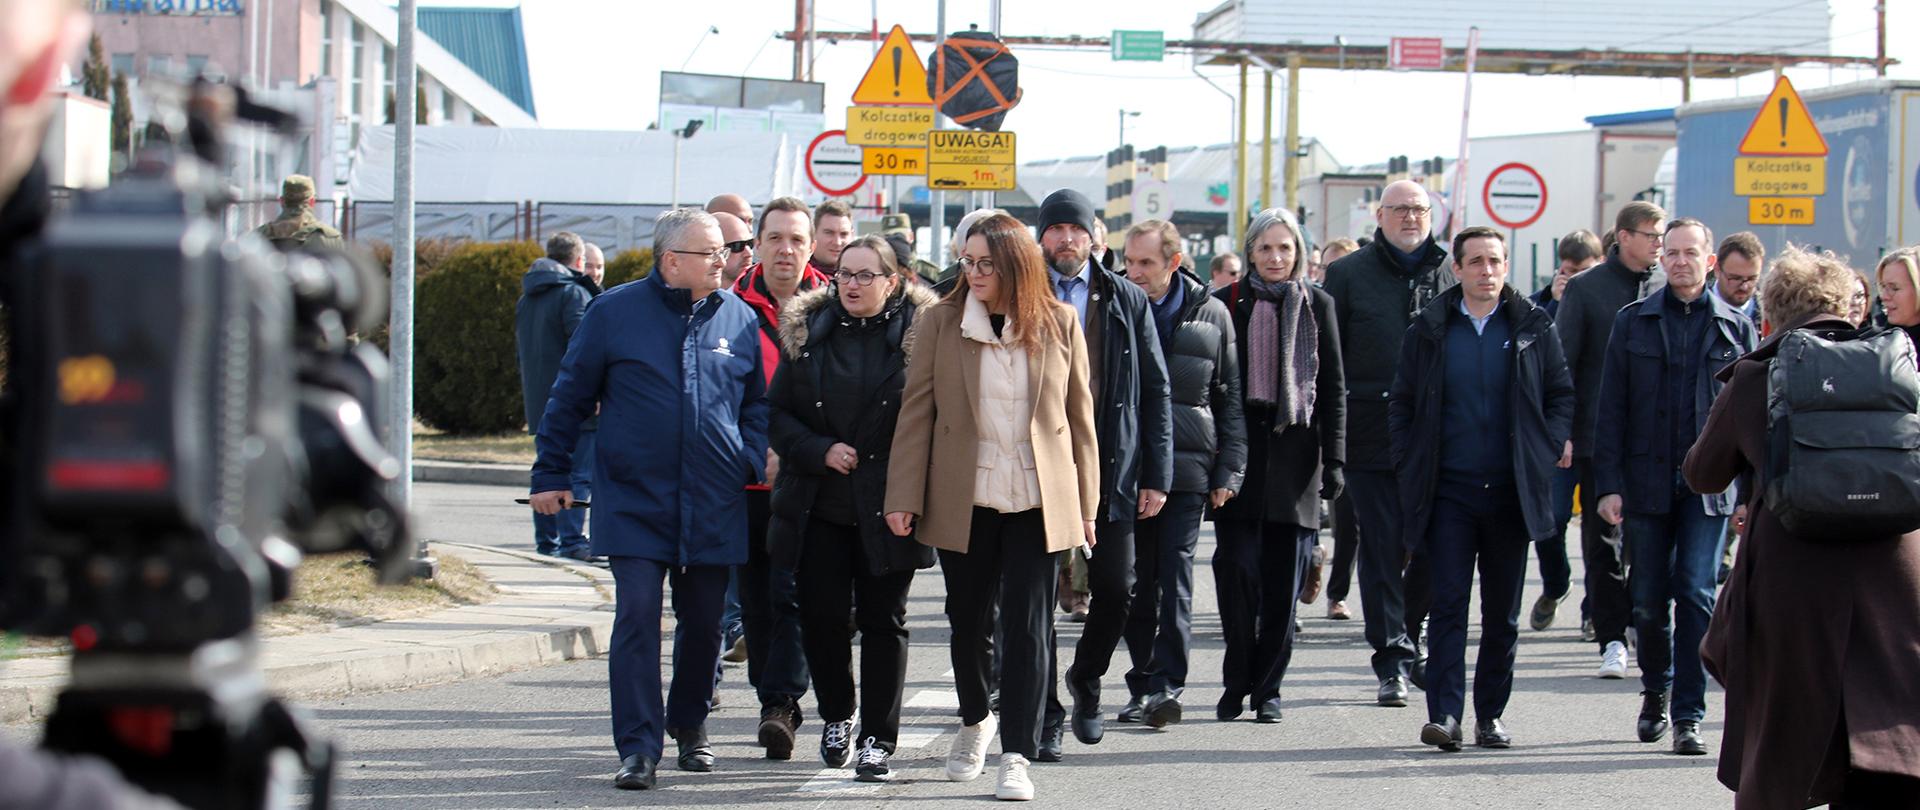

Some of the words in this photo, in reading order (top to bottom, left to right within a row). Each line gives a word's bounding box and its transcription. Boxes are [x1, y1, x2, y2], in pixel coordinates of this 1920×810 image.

[860, 110, 930, 123] Kolczatka
[864, 130, 927, 144] drogowa
[934, 133, 1010, 148] UWAGA!
[874, 153, 898, 169] 30
[903, 159, 918, 169] m
[1747, 160, 1812, 173] Kolczatka
[974, 169, 994, 181] 1m
[1750, 180, 1808, 194] drogowa
[1146, 193, 1160, 214] 5
[1761, 203, 1785, 219] 30
[1789, 208, 1805, 219] m
